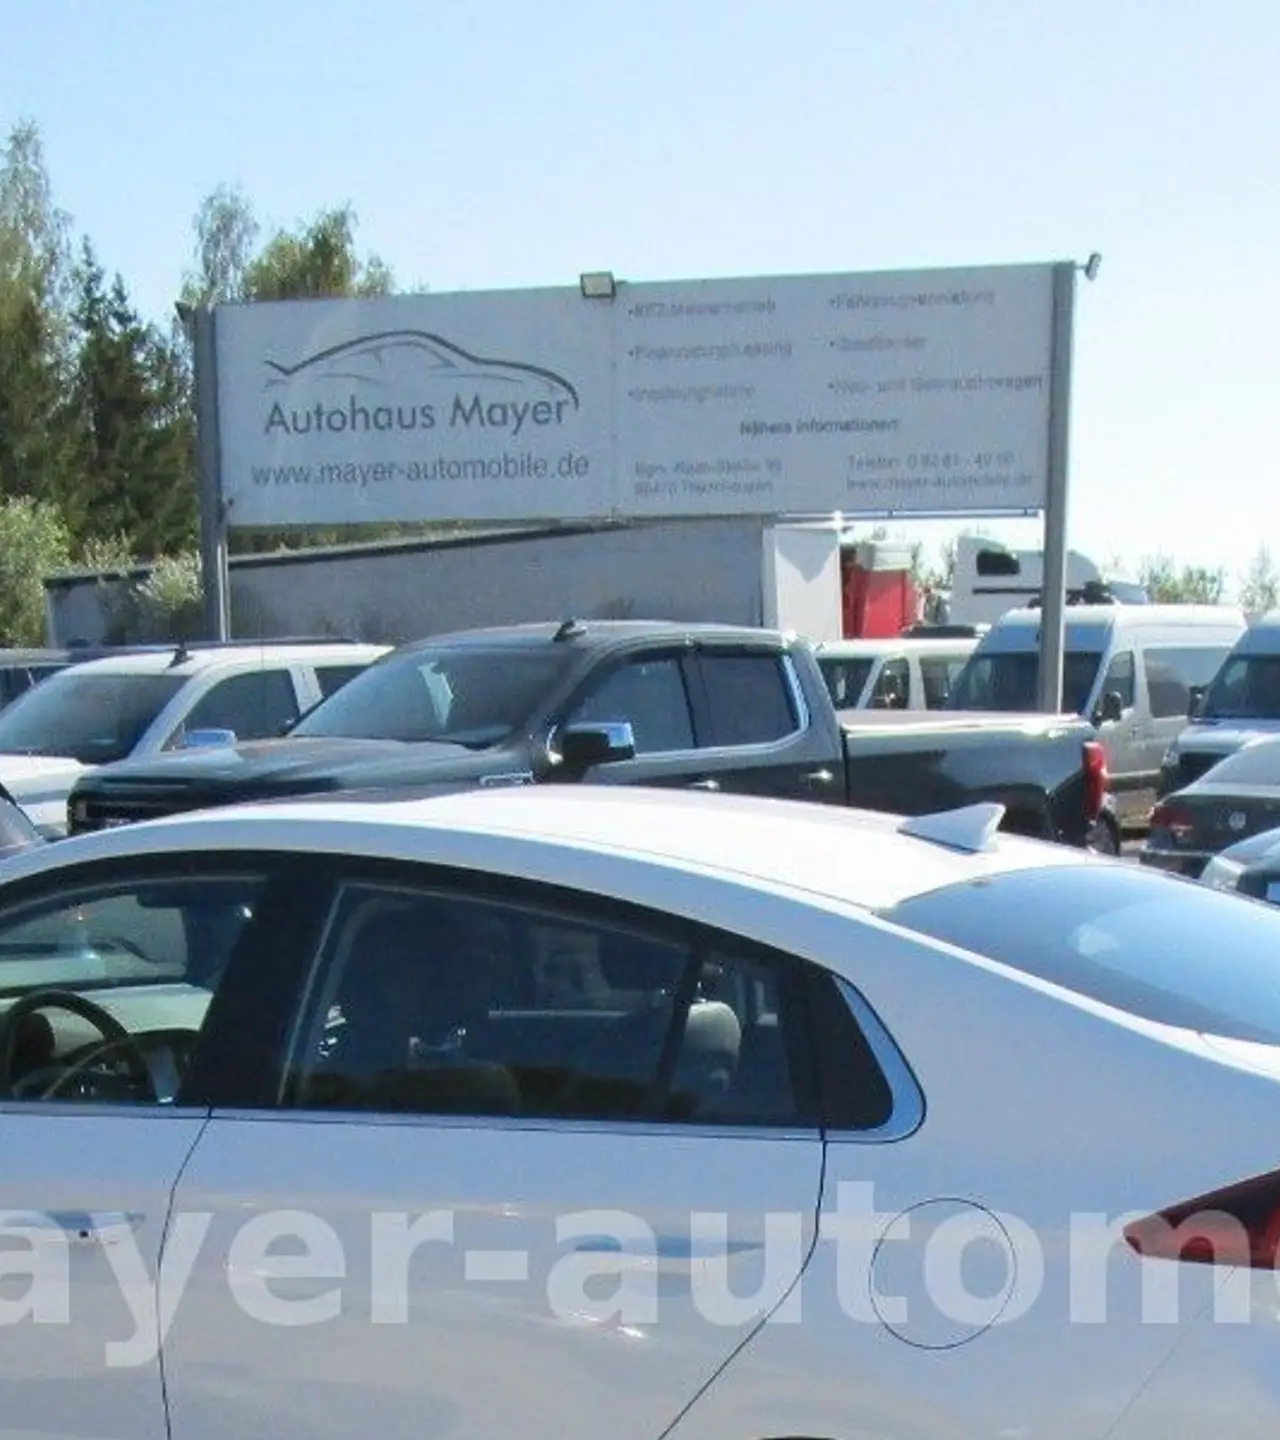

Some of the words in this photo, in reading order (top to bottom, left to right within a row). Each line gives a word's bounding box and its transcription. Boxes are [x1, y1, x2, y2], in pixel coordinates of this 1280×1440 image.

[264, 394, 436, 434] Autohaus
[449, 392, 569, 436] Mayer
[251, 451, 591, 488] www.mayer-automobile.de
